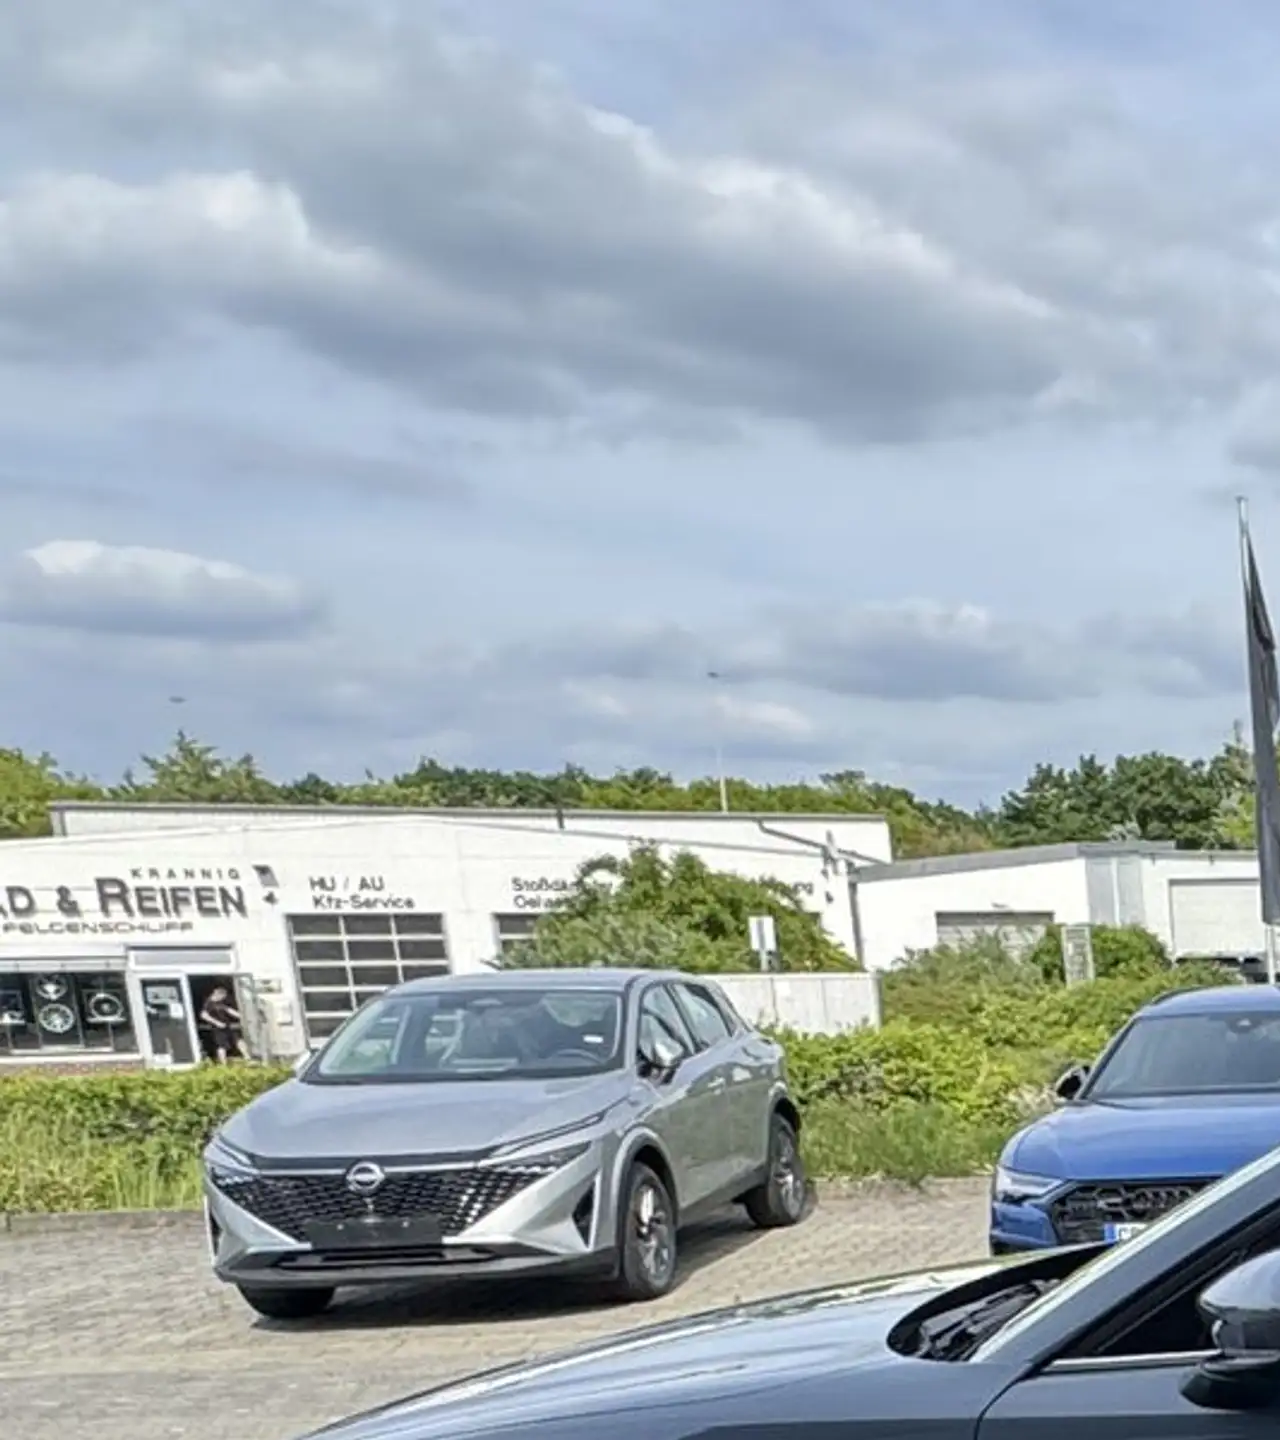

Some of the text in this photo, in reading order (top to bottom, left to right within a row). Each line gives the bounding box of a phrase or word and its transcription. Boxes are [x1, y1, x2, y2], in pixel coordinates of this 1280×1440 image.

[56, 885, 82, 918] &
[95, 876, 248, 919] REIFEN
[308, 875, 337, 891] HU
[358, 875, 386, 891] AU
